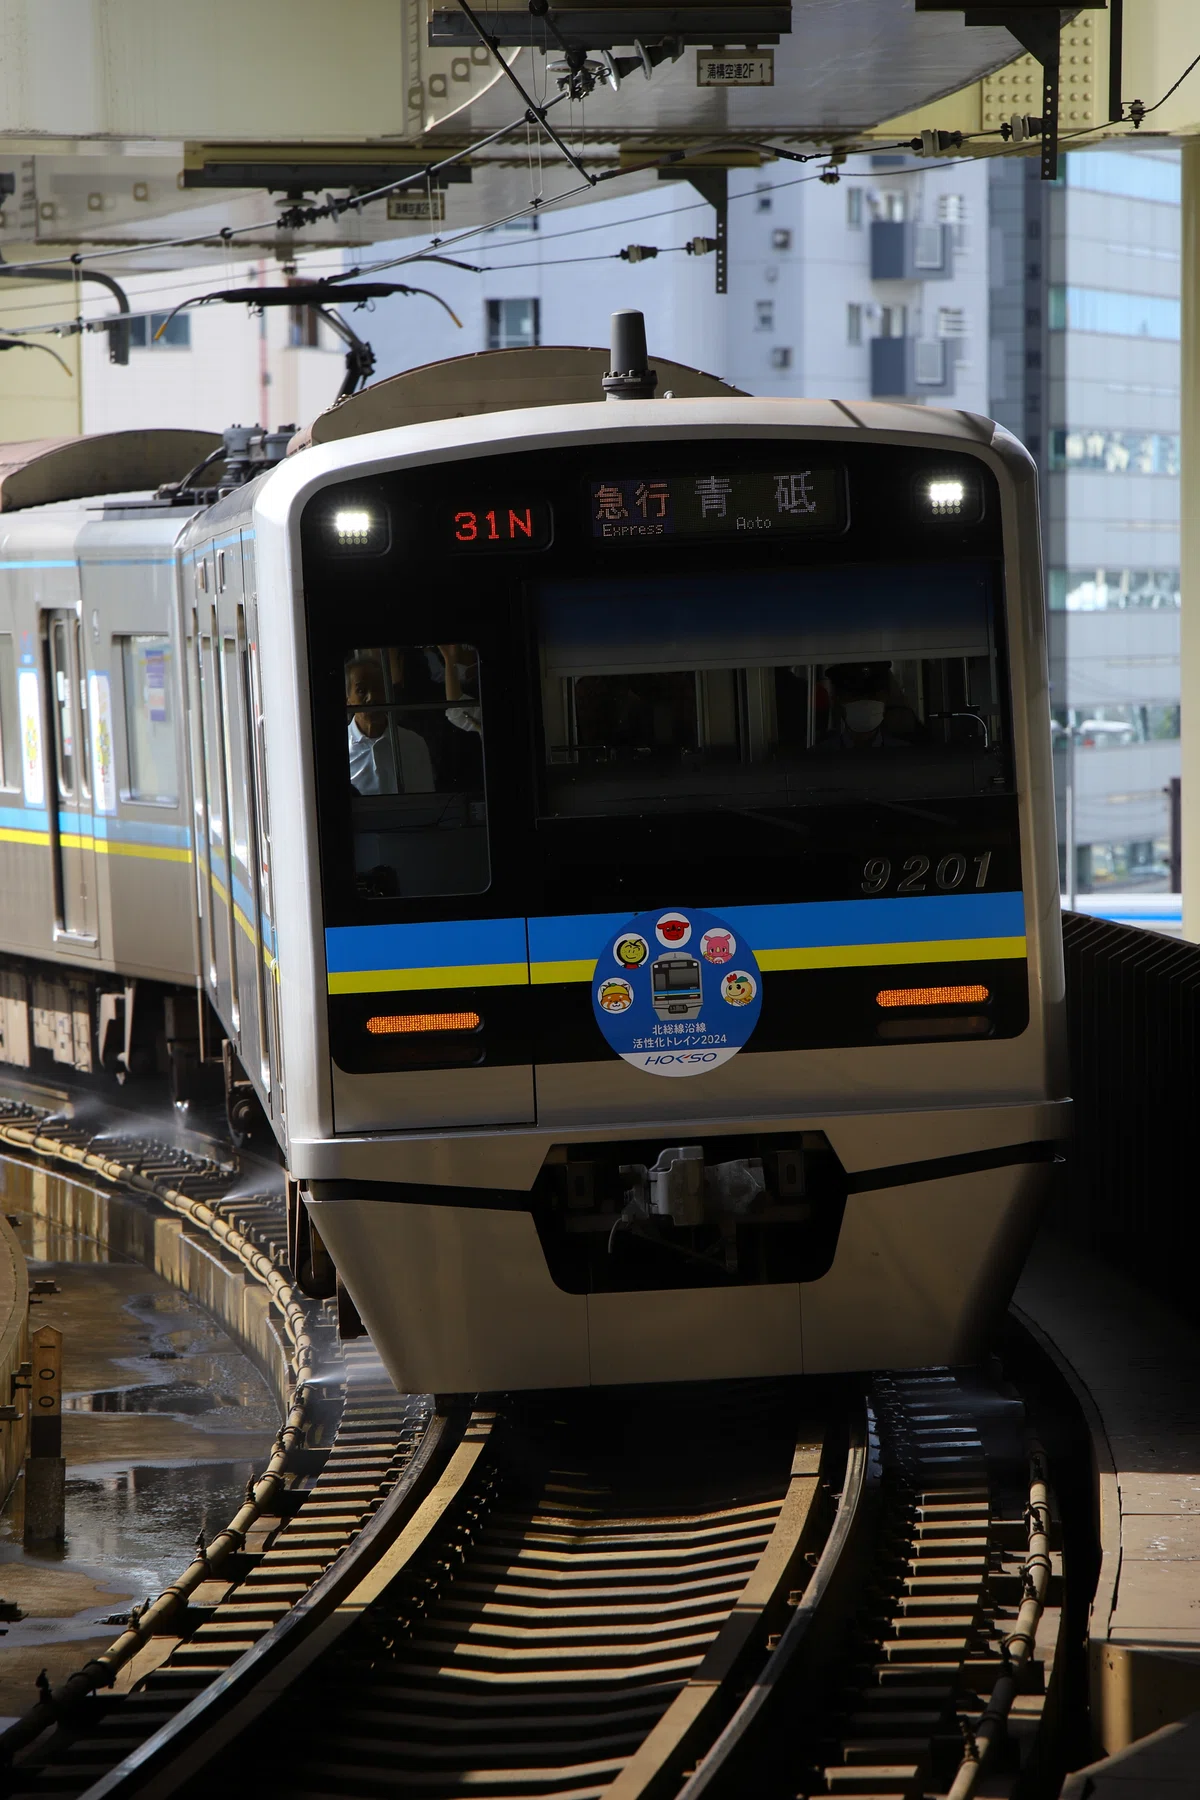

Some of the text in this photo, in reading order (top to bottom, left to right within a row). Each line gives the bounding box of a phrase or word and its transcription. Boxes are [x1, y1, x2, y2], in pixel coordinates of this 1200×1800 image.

[759, 63, 764, 78] 1
[594, 470, 817, 520] 急行 青砥
[454, 508, 532, 541] 31N
[602, 516, 772, 537] Express Aoto
[860, 851, 992, 894] 9201
[652, 1022, 707, 1035] 北総線沿線
[632, 1034, 727, 1048] 活性化トレイン2024
